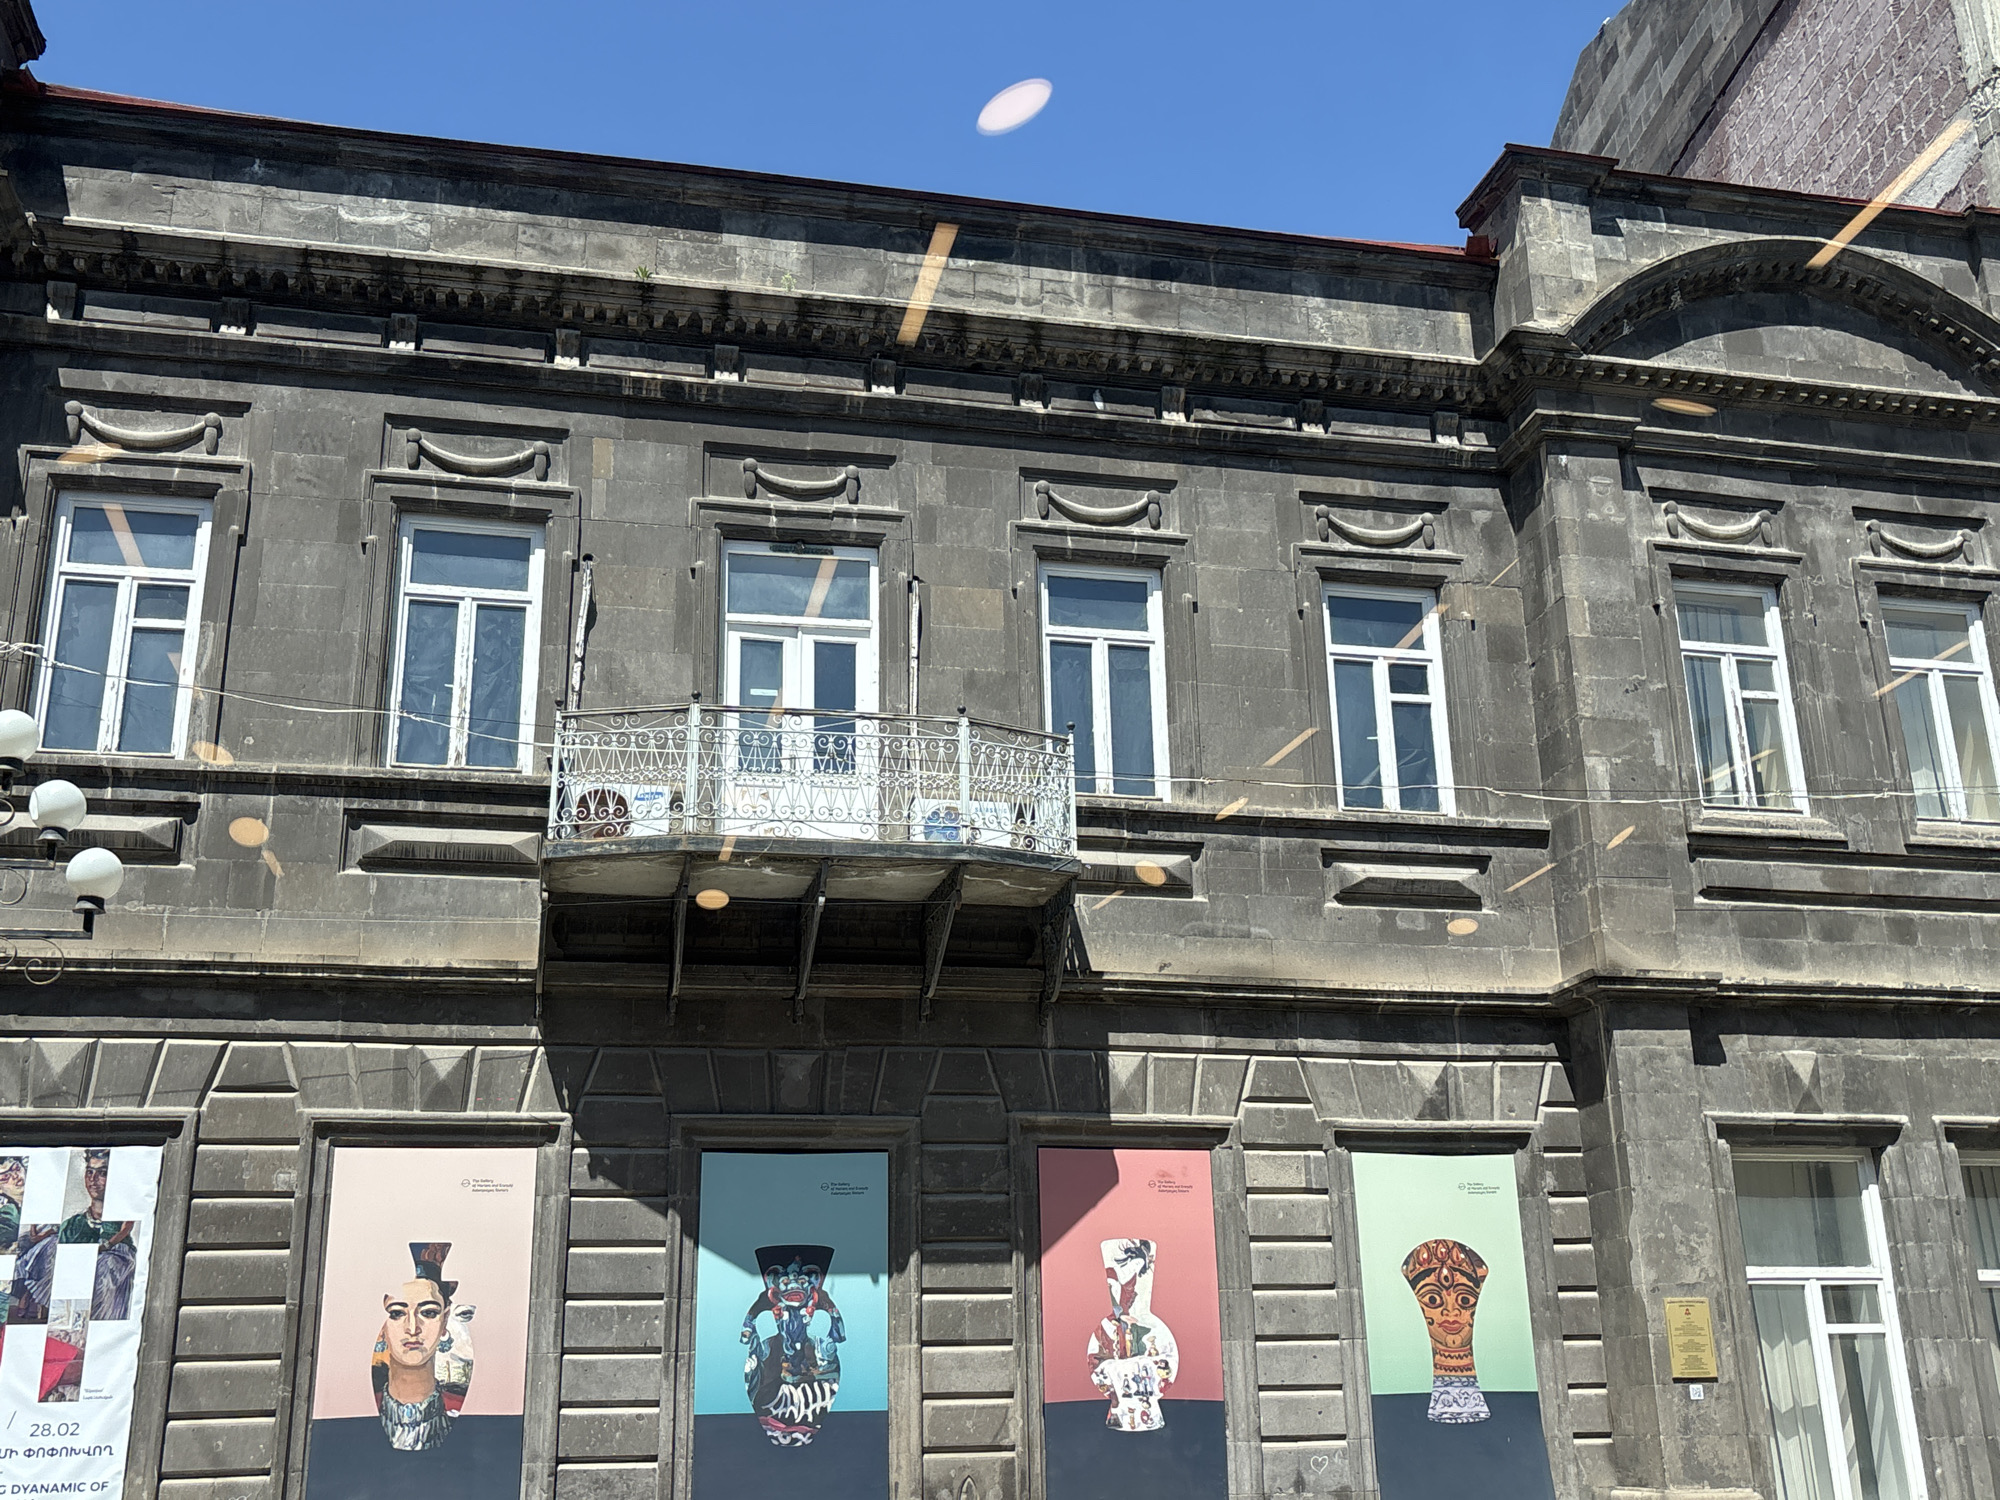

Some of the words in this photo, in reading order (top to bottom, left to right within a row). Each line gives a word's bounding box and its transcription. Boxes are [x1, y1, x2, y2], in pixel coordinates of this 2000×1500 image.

[29, 1422, 80, 1437] 28.02
[23, 1445, 114, 1458] ՓՈՓՈԽՎՈՂ
[11, 1482, 86, 1494] DYANAMIC
[90, 1481, 109, 1492] OF
